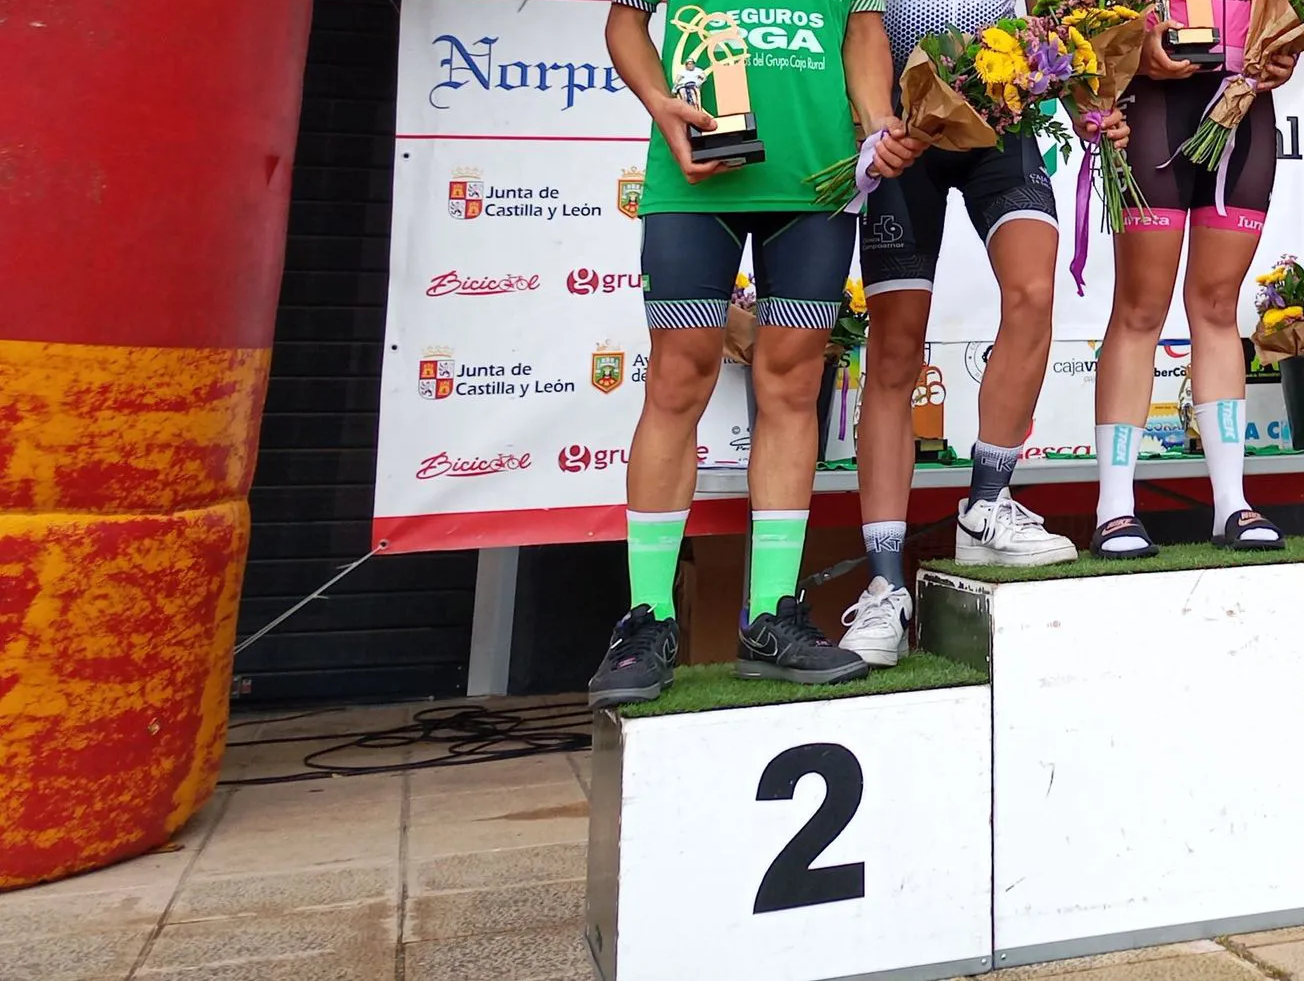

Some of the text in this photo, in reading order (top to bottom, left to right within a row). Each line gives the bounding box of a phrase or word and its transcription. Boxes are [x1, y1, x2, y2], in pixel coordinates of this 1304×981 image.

[752, 52, 765, 67] del
[765, 53, 790, 71] Grupo
[807, 56, 826, 71] Rural
[485, 185, 560, 200] Junta de
[484, 203, 602, 221] Castilla y León
[456, 363, 532, 377] Junta de
[455, 379, 576, 398] Castilla y León
[753, 742, 865, 915] 2
